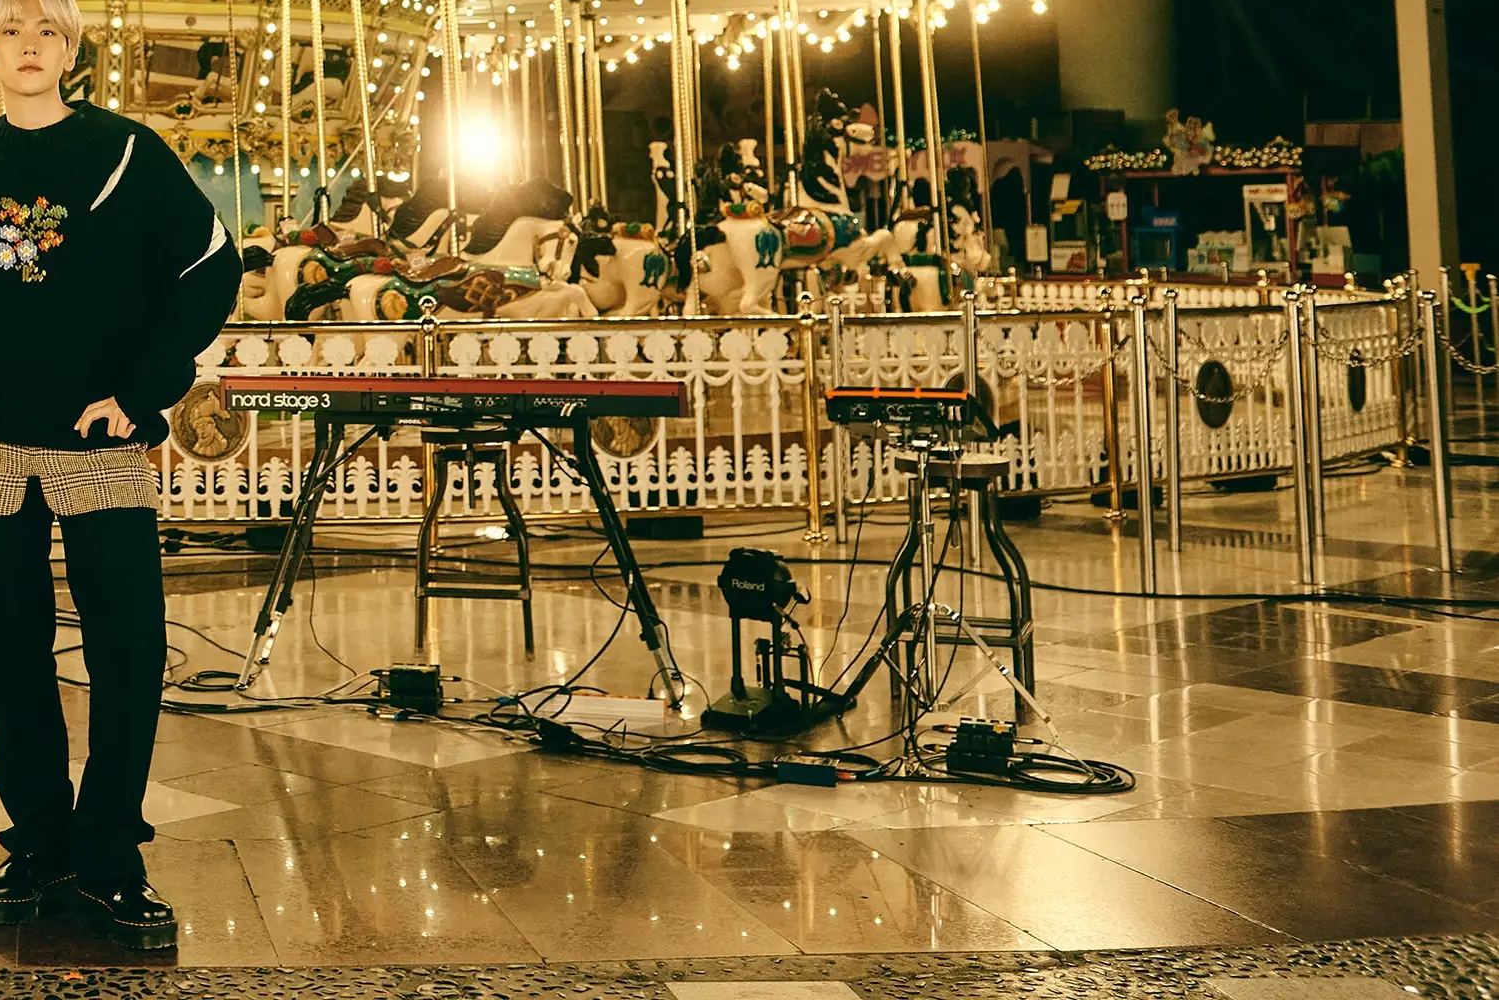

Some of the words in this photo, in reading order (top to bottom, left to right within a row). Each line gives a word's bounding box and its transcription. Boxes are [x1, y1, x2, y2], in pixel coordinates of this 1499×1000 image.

[231, 392, 270, 407] nord
[273, 393, 319, 409] stage
[320, 393, 331, 408] 3
[731, 578, 765, 592] Roland
